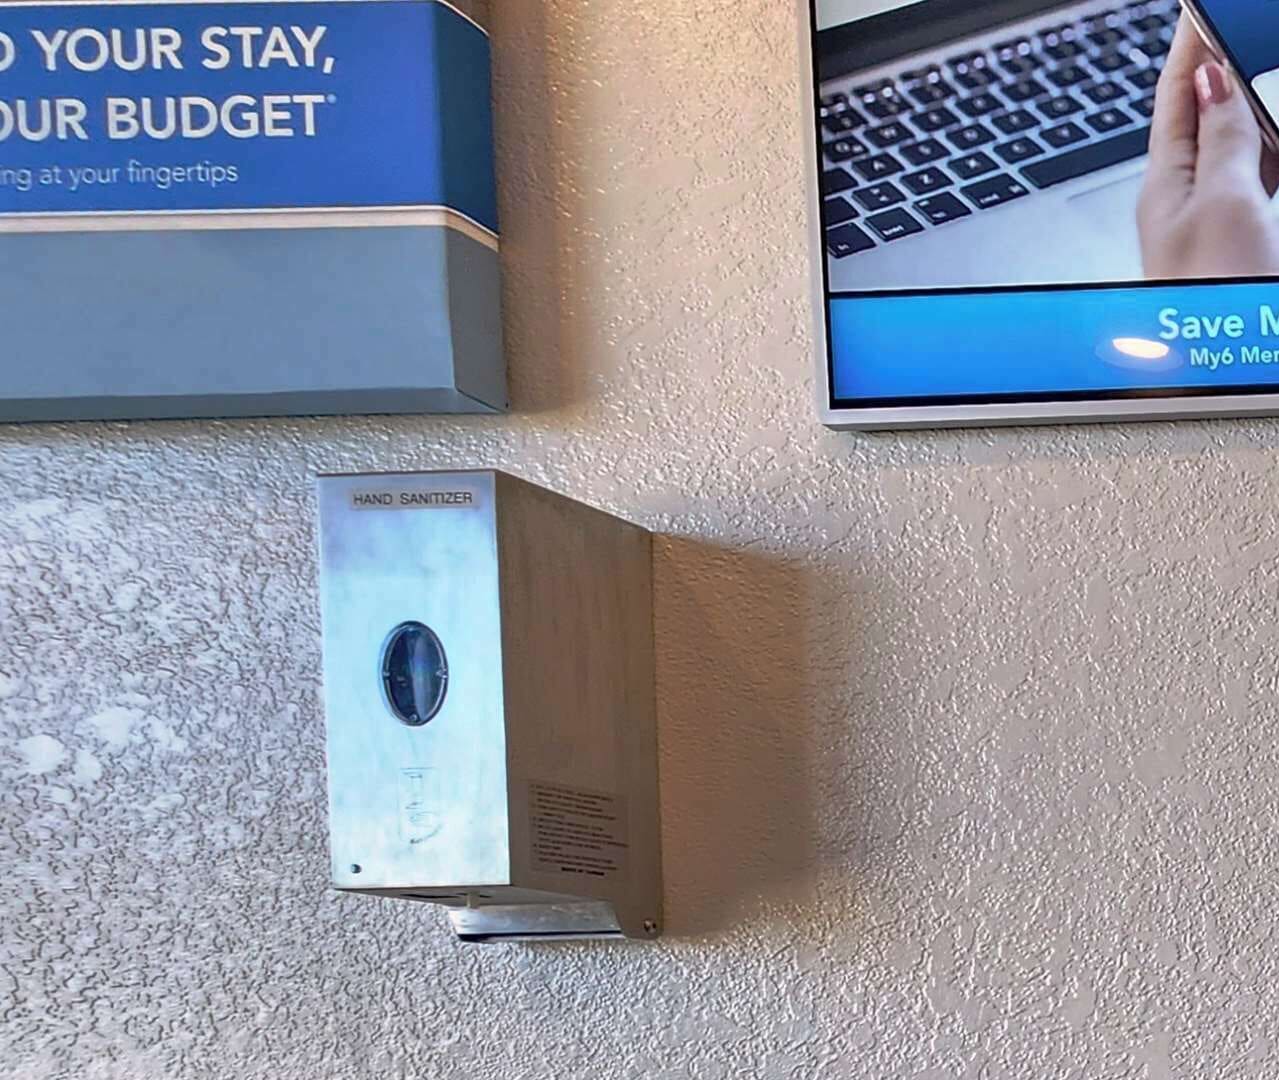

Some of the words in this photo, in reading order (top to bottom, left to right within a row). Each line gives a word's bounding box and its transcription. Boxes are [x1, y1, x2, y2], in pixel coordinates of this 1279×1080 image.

[31, 27, 184, 71] YOUR
[200, 26, 335, 74] STAY,
[0, 97, 89, 141] UR
[39, 165, 61, 184] at
[68, 167, 120, 191] your
[128, 159, 240, 189] fingertips
[1158, 308, 1245, 342] Save
[1190, 346, 1234, 371] My6
[353, 492, 393, 505] HAND
[400, 491, 473, 505] SANITIZER
